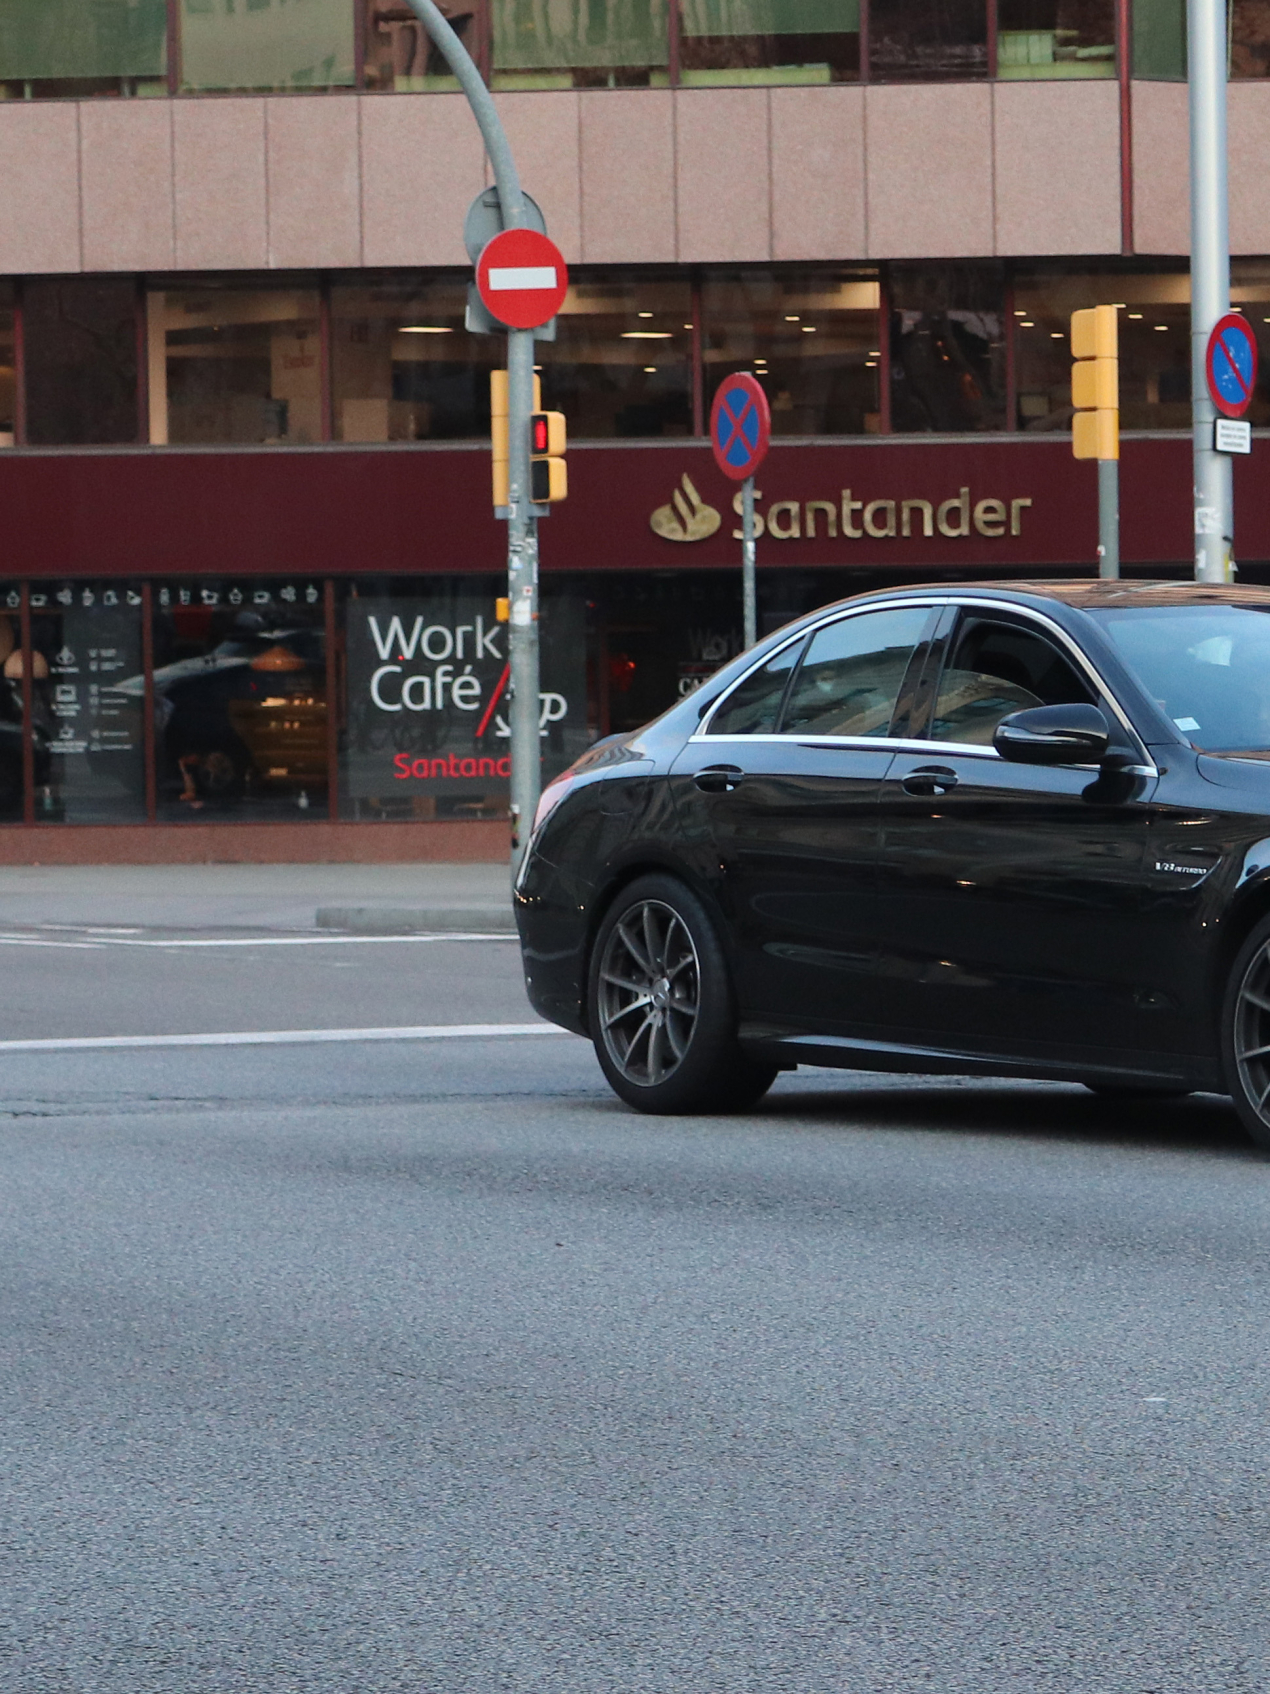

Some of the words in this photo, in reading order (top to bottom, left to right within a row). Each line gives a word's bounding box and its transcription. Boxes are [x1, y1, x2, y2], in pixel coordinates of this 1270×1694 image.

[731, 486, 1032, 540] Santander
[367, 614, 502, 661] Work
[370, 664, 482, 712] Café
